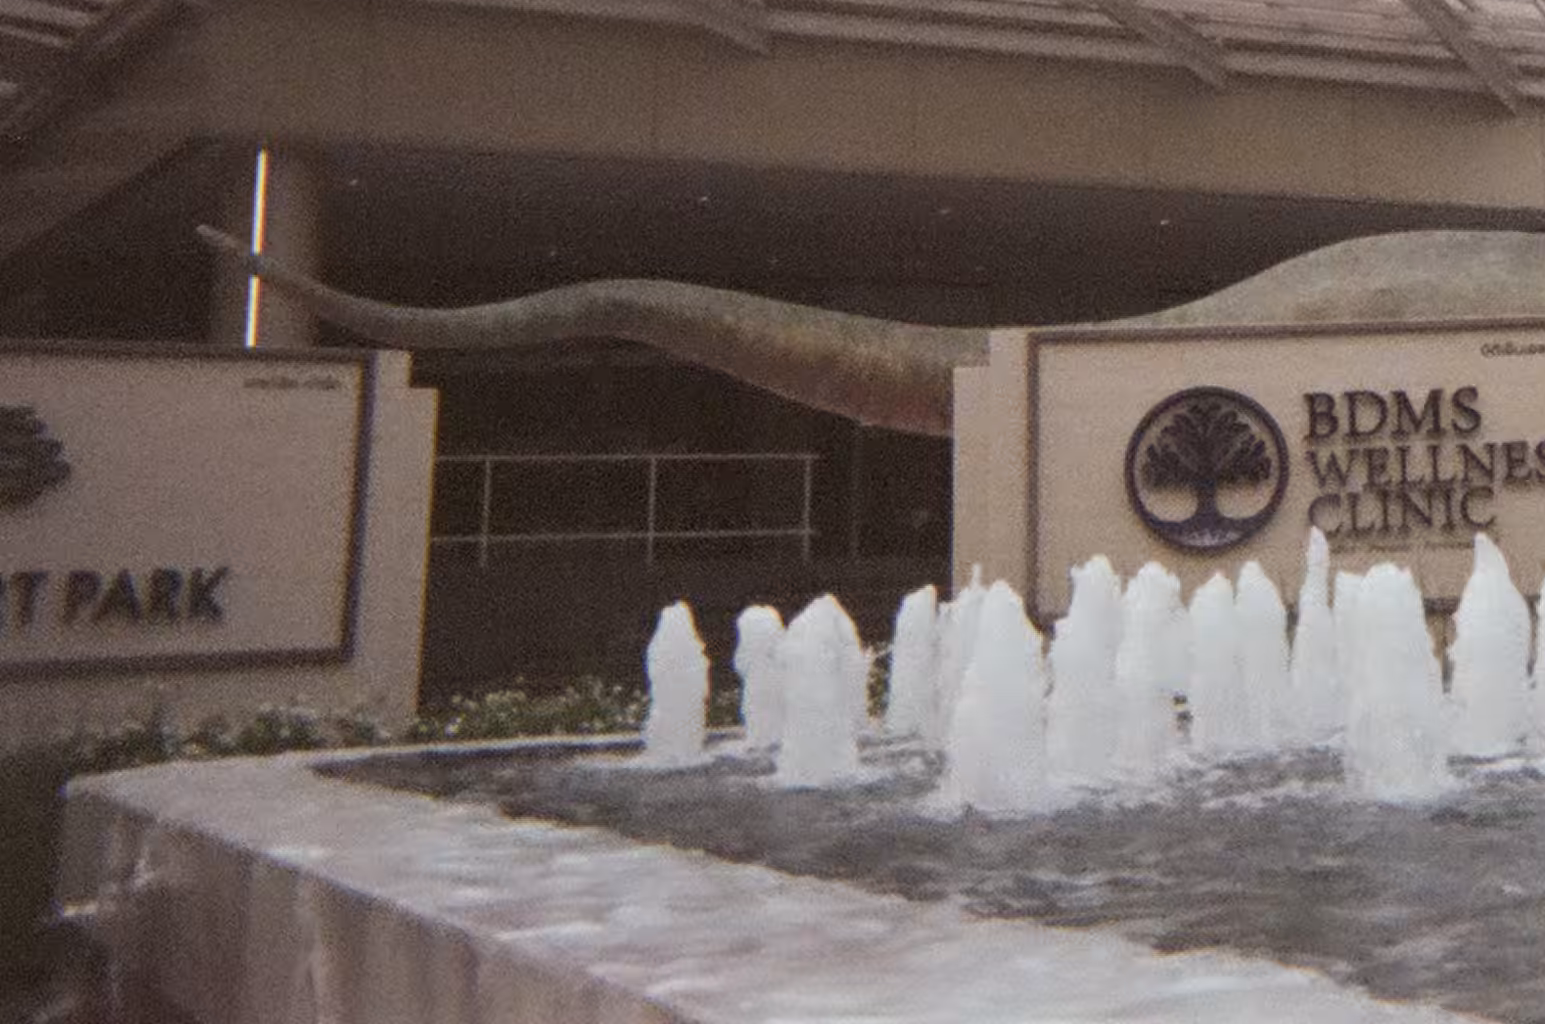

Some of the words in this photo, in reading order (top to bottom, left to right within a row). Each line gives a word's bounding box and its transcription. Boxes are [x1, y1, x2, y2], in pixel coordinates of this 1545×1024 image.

[1304, 387, 1482, 440] BDMS
[1308, 485, 1497, 536] CLINIC
[0, 570, 48, 627] T
[63, 567, 229, 625] PARK
